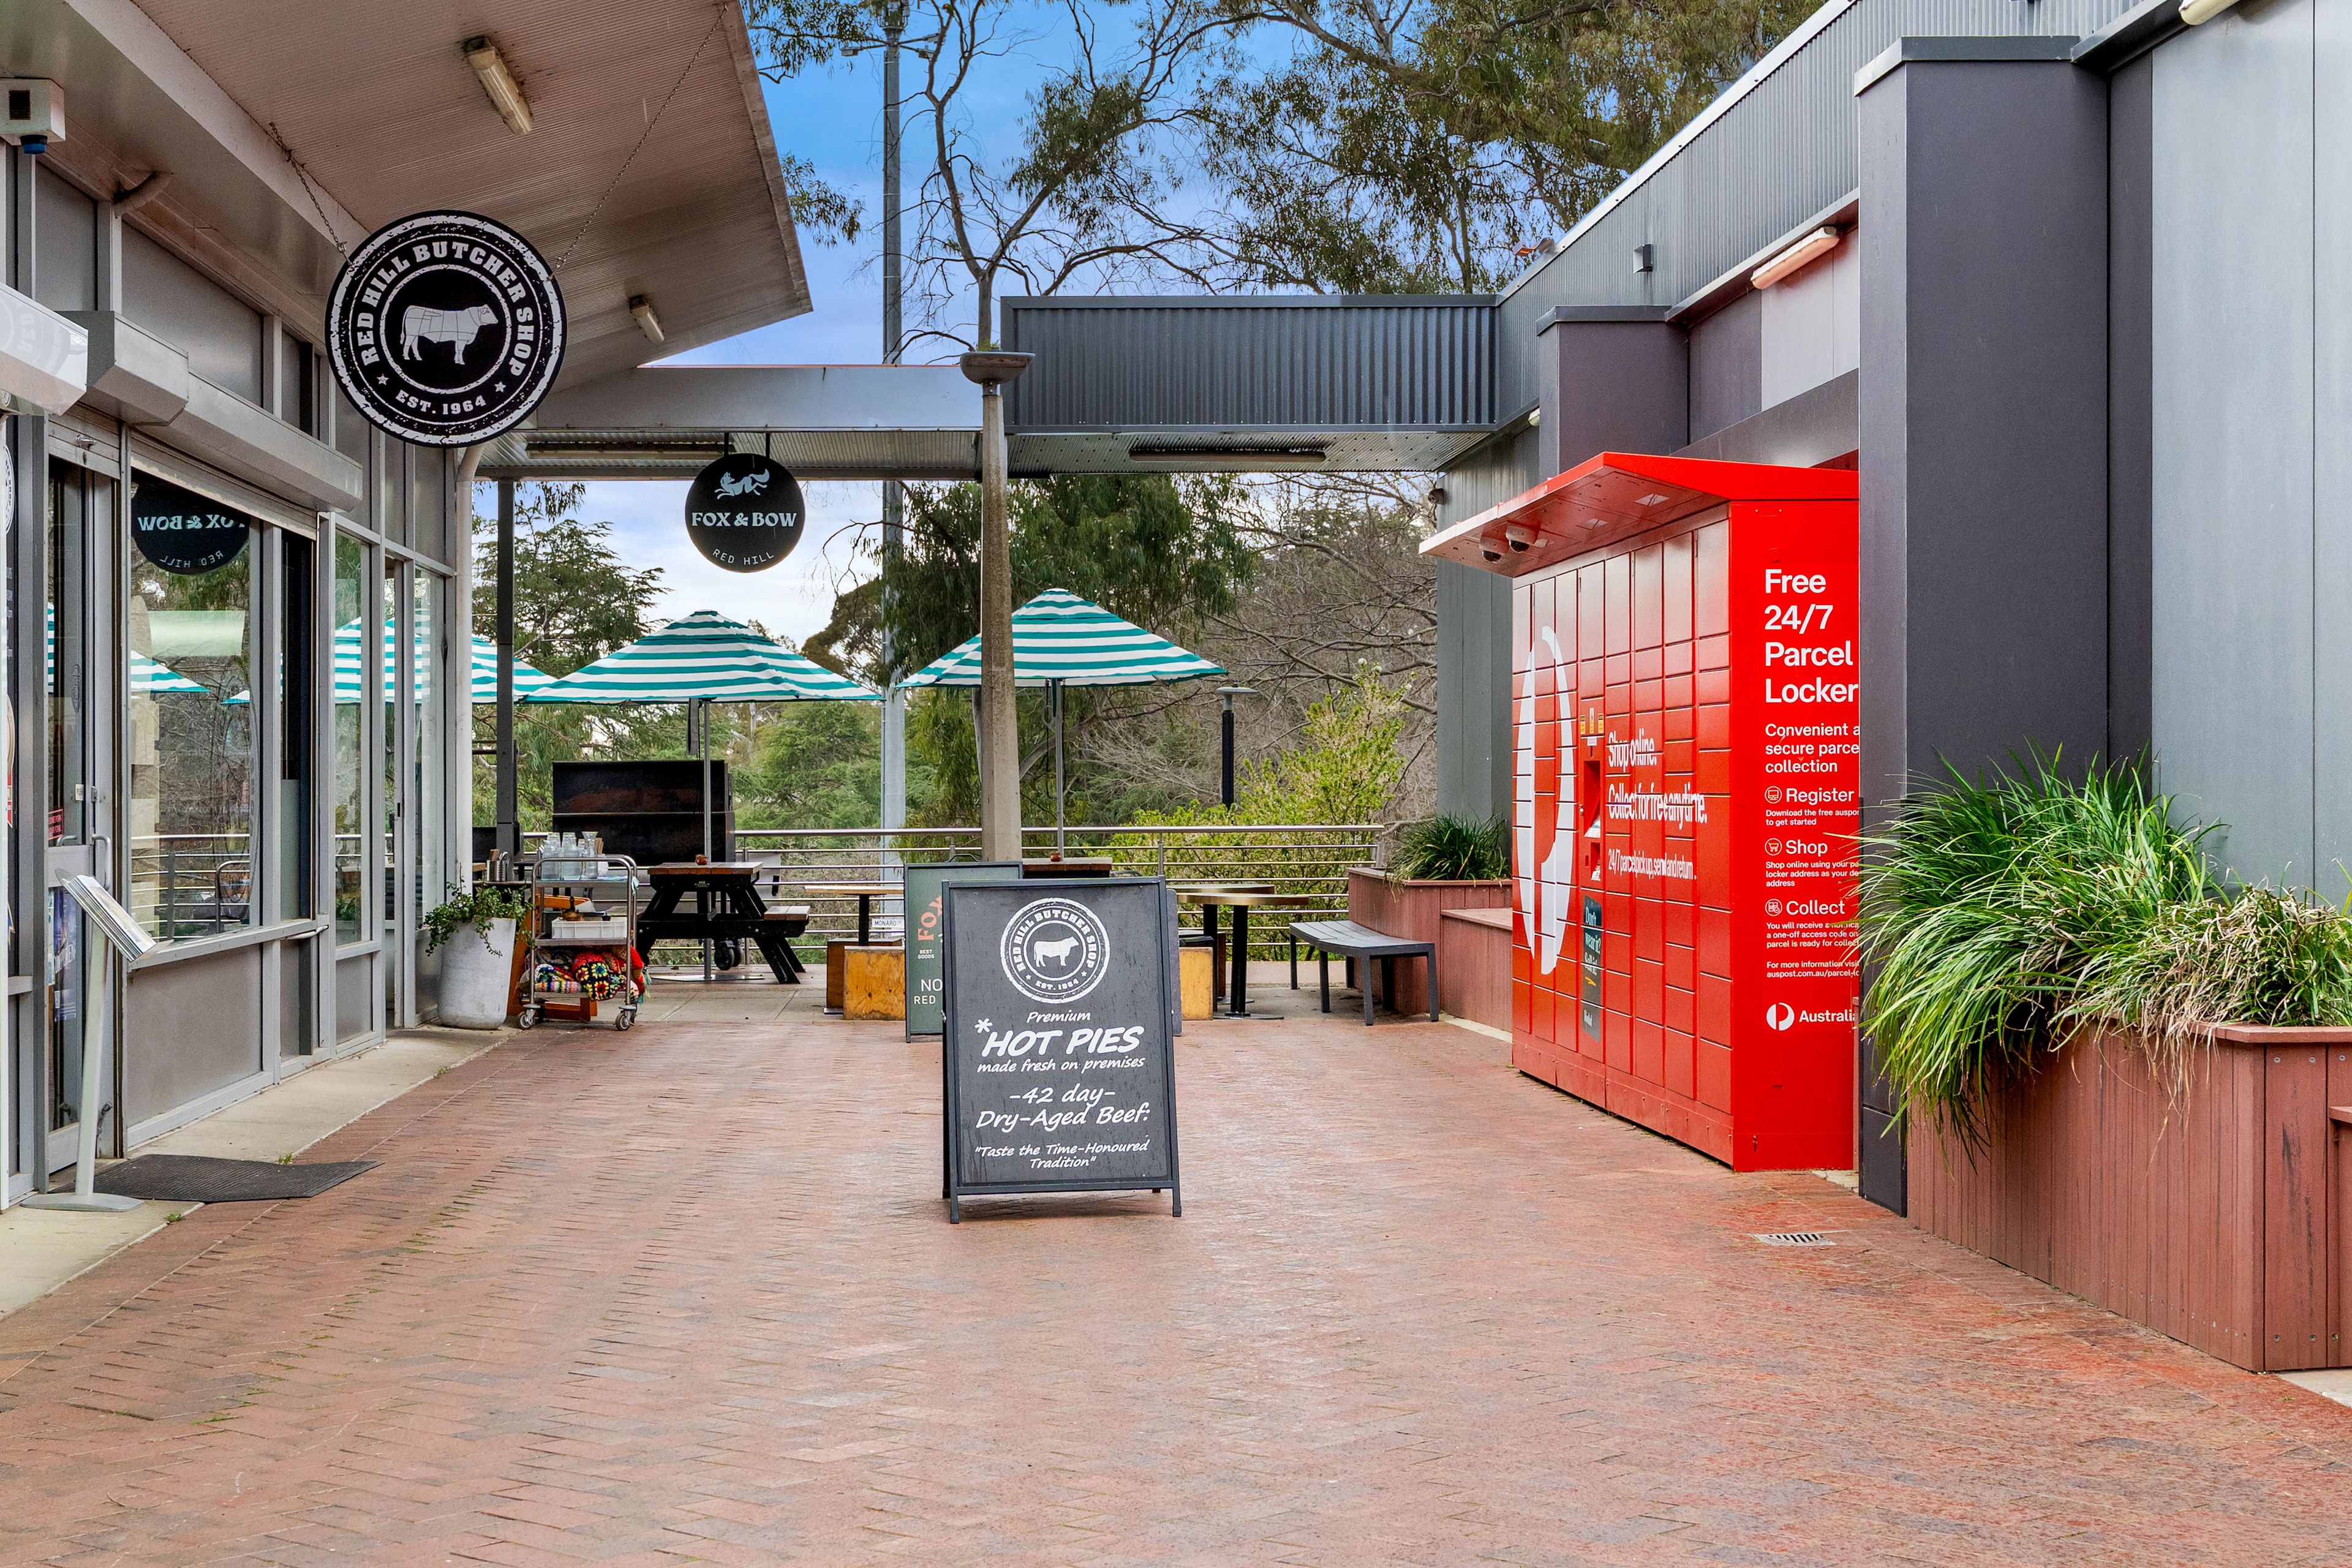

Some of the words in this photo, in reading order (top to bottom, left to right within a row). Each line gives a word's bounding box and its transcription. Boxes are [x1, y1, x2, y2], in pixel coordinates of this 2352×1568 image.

[361, 256, 411, 307] HILL
[412, 241, 526, 303] BUTCHER
[357, 312, 380, 366] RED
[510, 307, 533, 377] SHOP
[396, 390, 436, 414] EST.
[442, 395, 486, 415] 1964
[692, 512, 731, 527] FOX
[734, 512, 748, 527] &
[752, 512, 797, 527] BOW
[712, 549, 734, 564] RED
[744, 552, 774, 565] HILL
[1765, 569, 1826, 594] Free
[1765, 603, 1833, 634] 24/7
[1765, 640, 1853, 666] Parcel
[1765, 677, 1859, 703] Locker
[1765, 723, 1849, 737] Convenient
[1608, 731, 1629, 773] Shop
[1630, 728, 1657, 766] online.
[1765, 744, 1814, 755] secure
[1765, 760, 1838, 773] collection
[1608, 783, 1637, 820] Collect
[1637, 782, 1649, 820] for
[1649, 782, 1668, 821] free
[1786, 787, 1855, 805] Register
[1776, 818, 1788, 827] get
[1785, 839, 1828, 857] Shop
[1608, 848, 1621, 875] 24/7
[1811, 861, 1830, 869] using
[1786, 899, 1845, 915] Collect
[1013, 919, 1035, 944] HILL
[1034, 910, 1091, 935] BUTCHER
[1087, 935, 1097, 968] SHOP
[1766, 940, 1790, 949] parcel
[1800, 940, 1820, 948] ready
[1012, 946, 1027, 972] RED
[914, 995, 936, 1005] RED
[1026, 1009, 1091, 1023] Premium
[1066, 1025, 1145, 1055] PIES
[977, 1059, 1017, 1073] made
[1020, 1058, 1056, 1072] fresh
[1061, 1061, 1078, 1071] on
[1080, 1055, 1146, 1074] premises
[975, 1105, 1091, 1133] Dry-Aged
[1019, 1144, 1040, 1156] the
[1046, 1139, 1150, 1155] Time-Honoured
[1030, 1156, 1096, 1169] Tradition"
